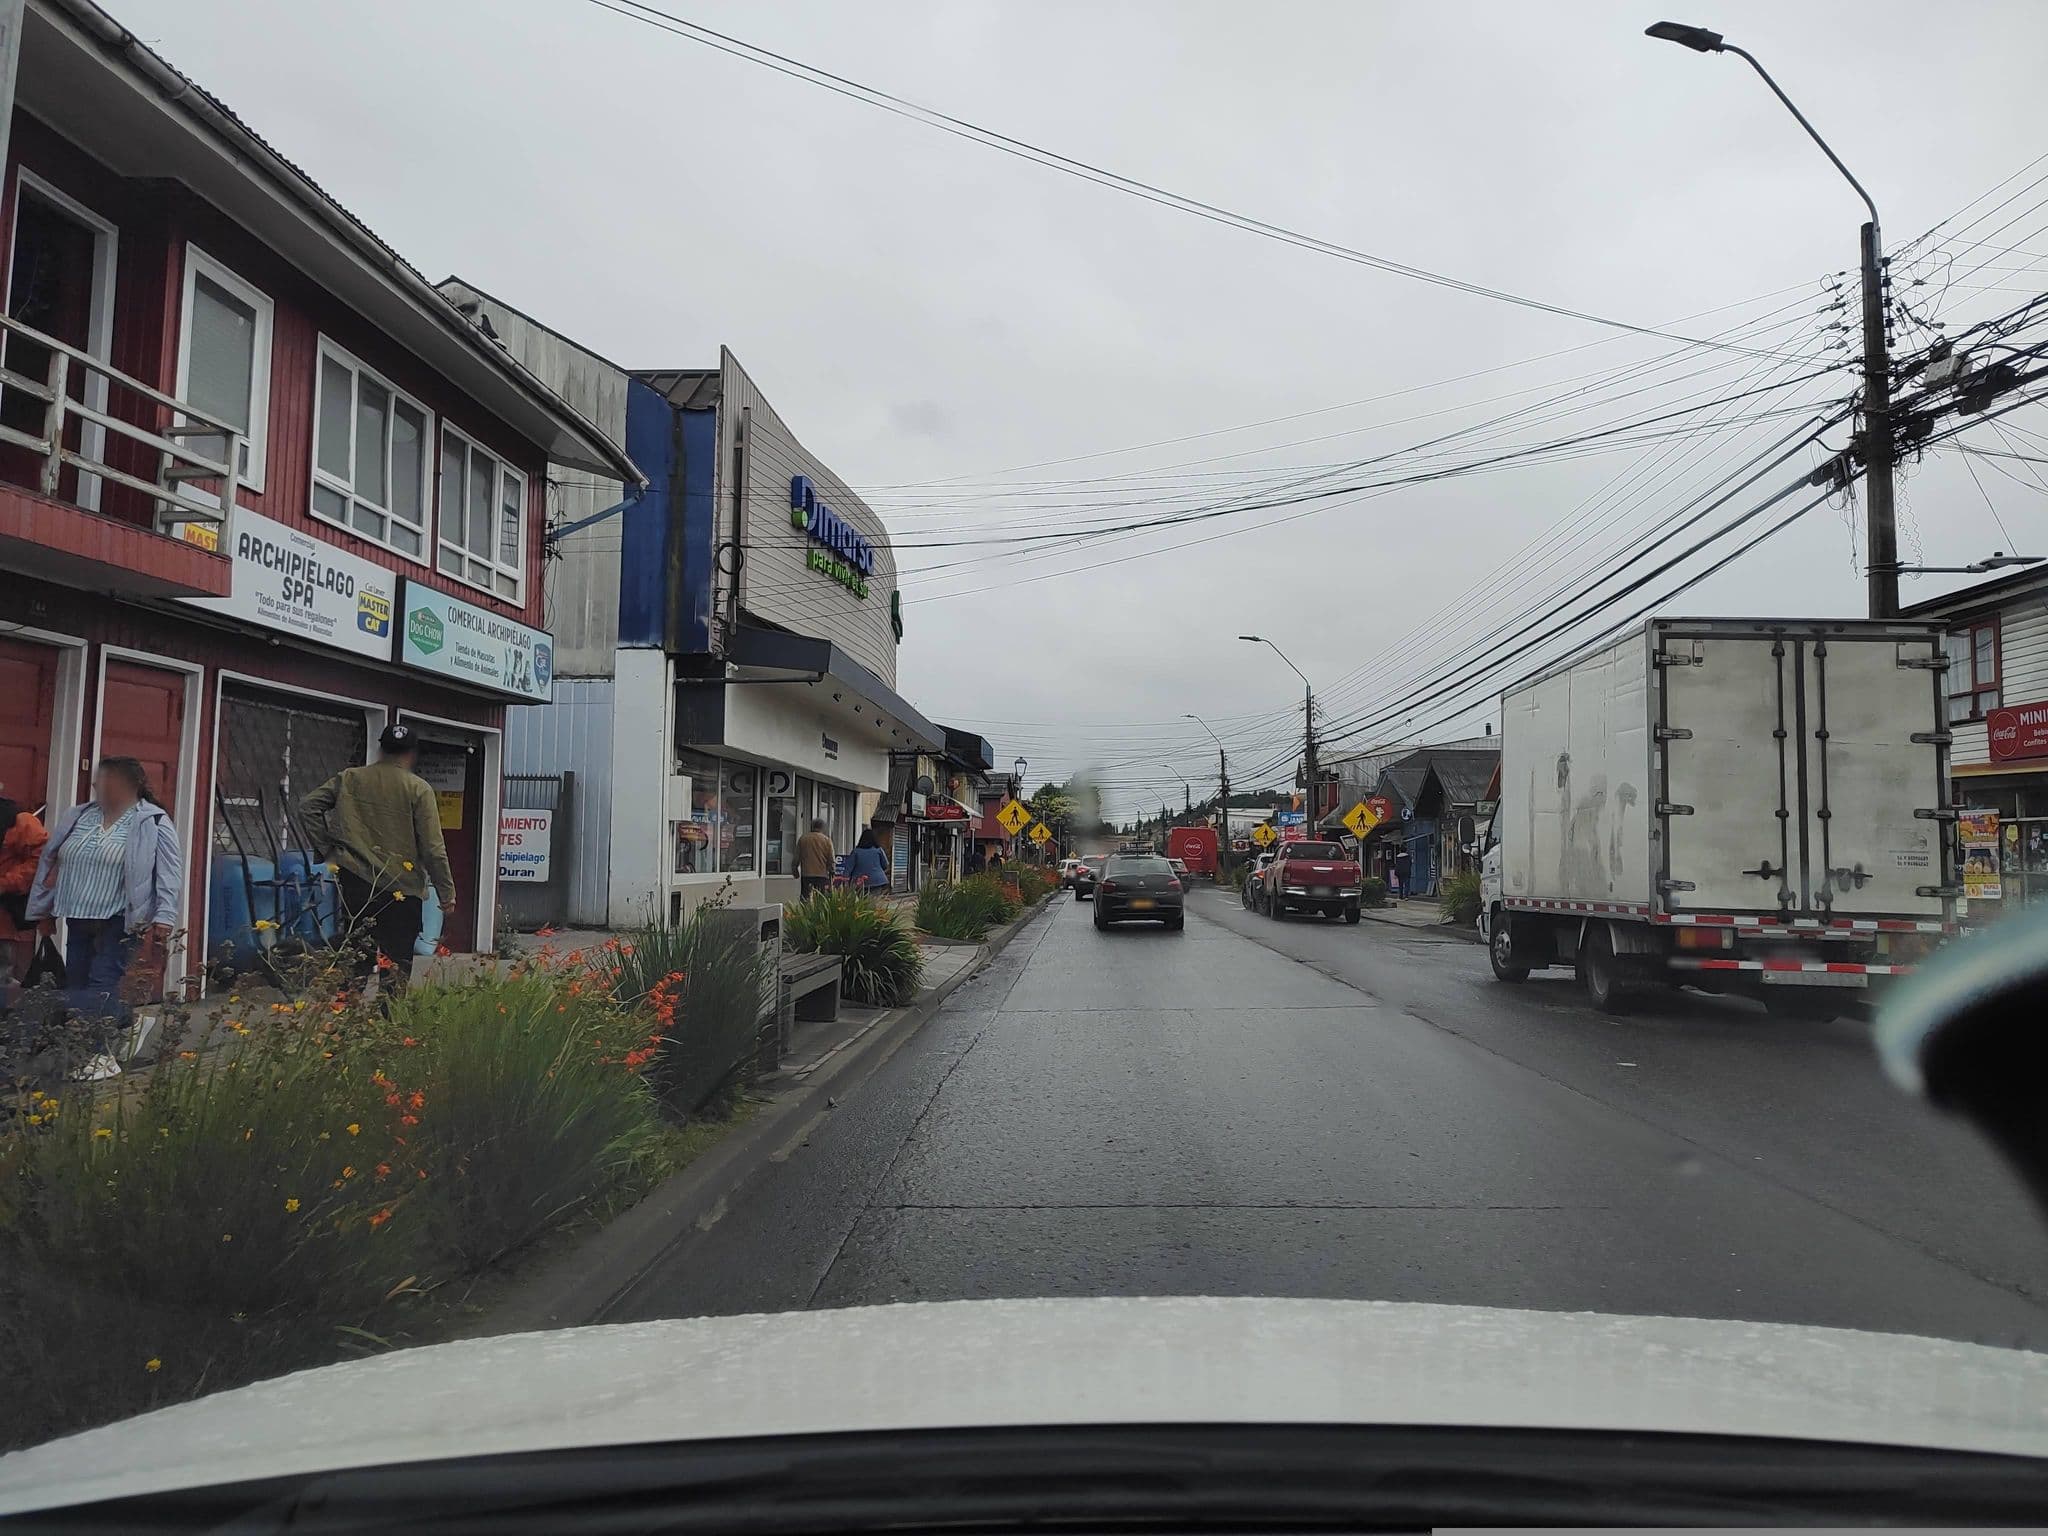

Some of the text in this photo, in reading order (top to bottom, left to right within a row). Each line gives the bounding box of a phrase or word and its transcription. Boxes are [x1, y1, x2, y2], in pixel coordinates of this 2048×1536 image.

[791, 475, 875, 575] Dimarso
[238, 532, 354, 598] ARCHIPIÉLAGO
[281, 576, 314, 609] SPA
[276, 599, 291, 613] para
[292, 606, 304, 617] sus
[360, 596, 390, 616] MASTER
[365, 616, 380, 632] CAT
[410, 620, 424, 636] DOG
[447, 606, 486, 635] COMERCIAL
[487, 623, 532, 650] ARCHIPIÉLAGO
[455, 642, 470, 656] Tienda
[470, 647, 477, 658] de
[454, 656, 473, 671] Alimento
[474, 661, 480, 672] de
[2020, 709, 2048, 726] MINI
[1994, 726, 2017, 741] Coca-Cola
[2023, 738, 2047, 747] Confites
[500, 817, 547, 831] AMIENTO
[500, 833, 523, 846] TES
[499, 866, 535, 877] Duran
